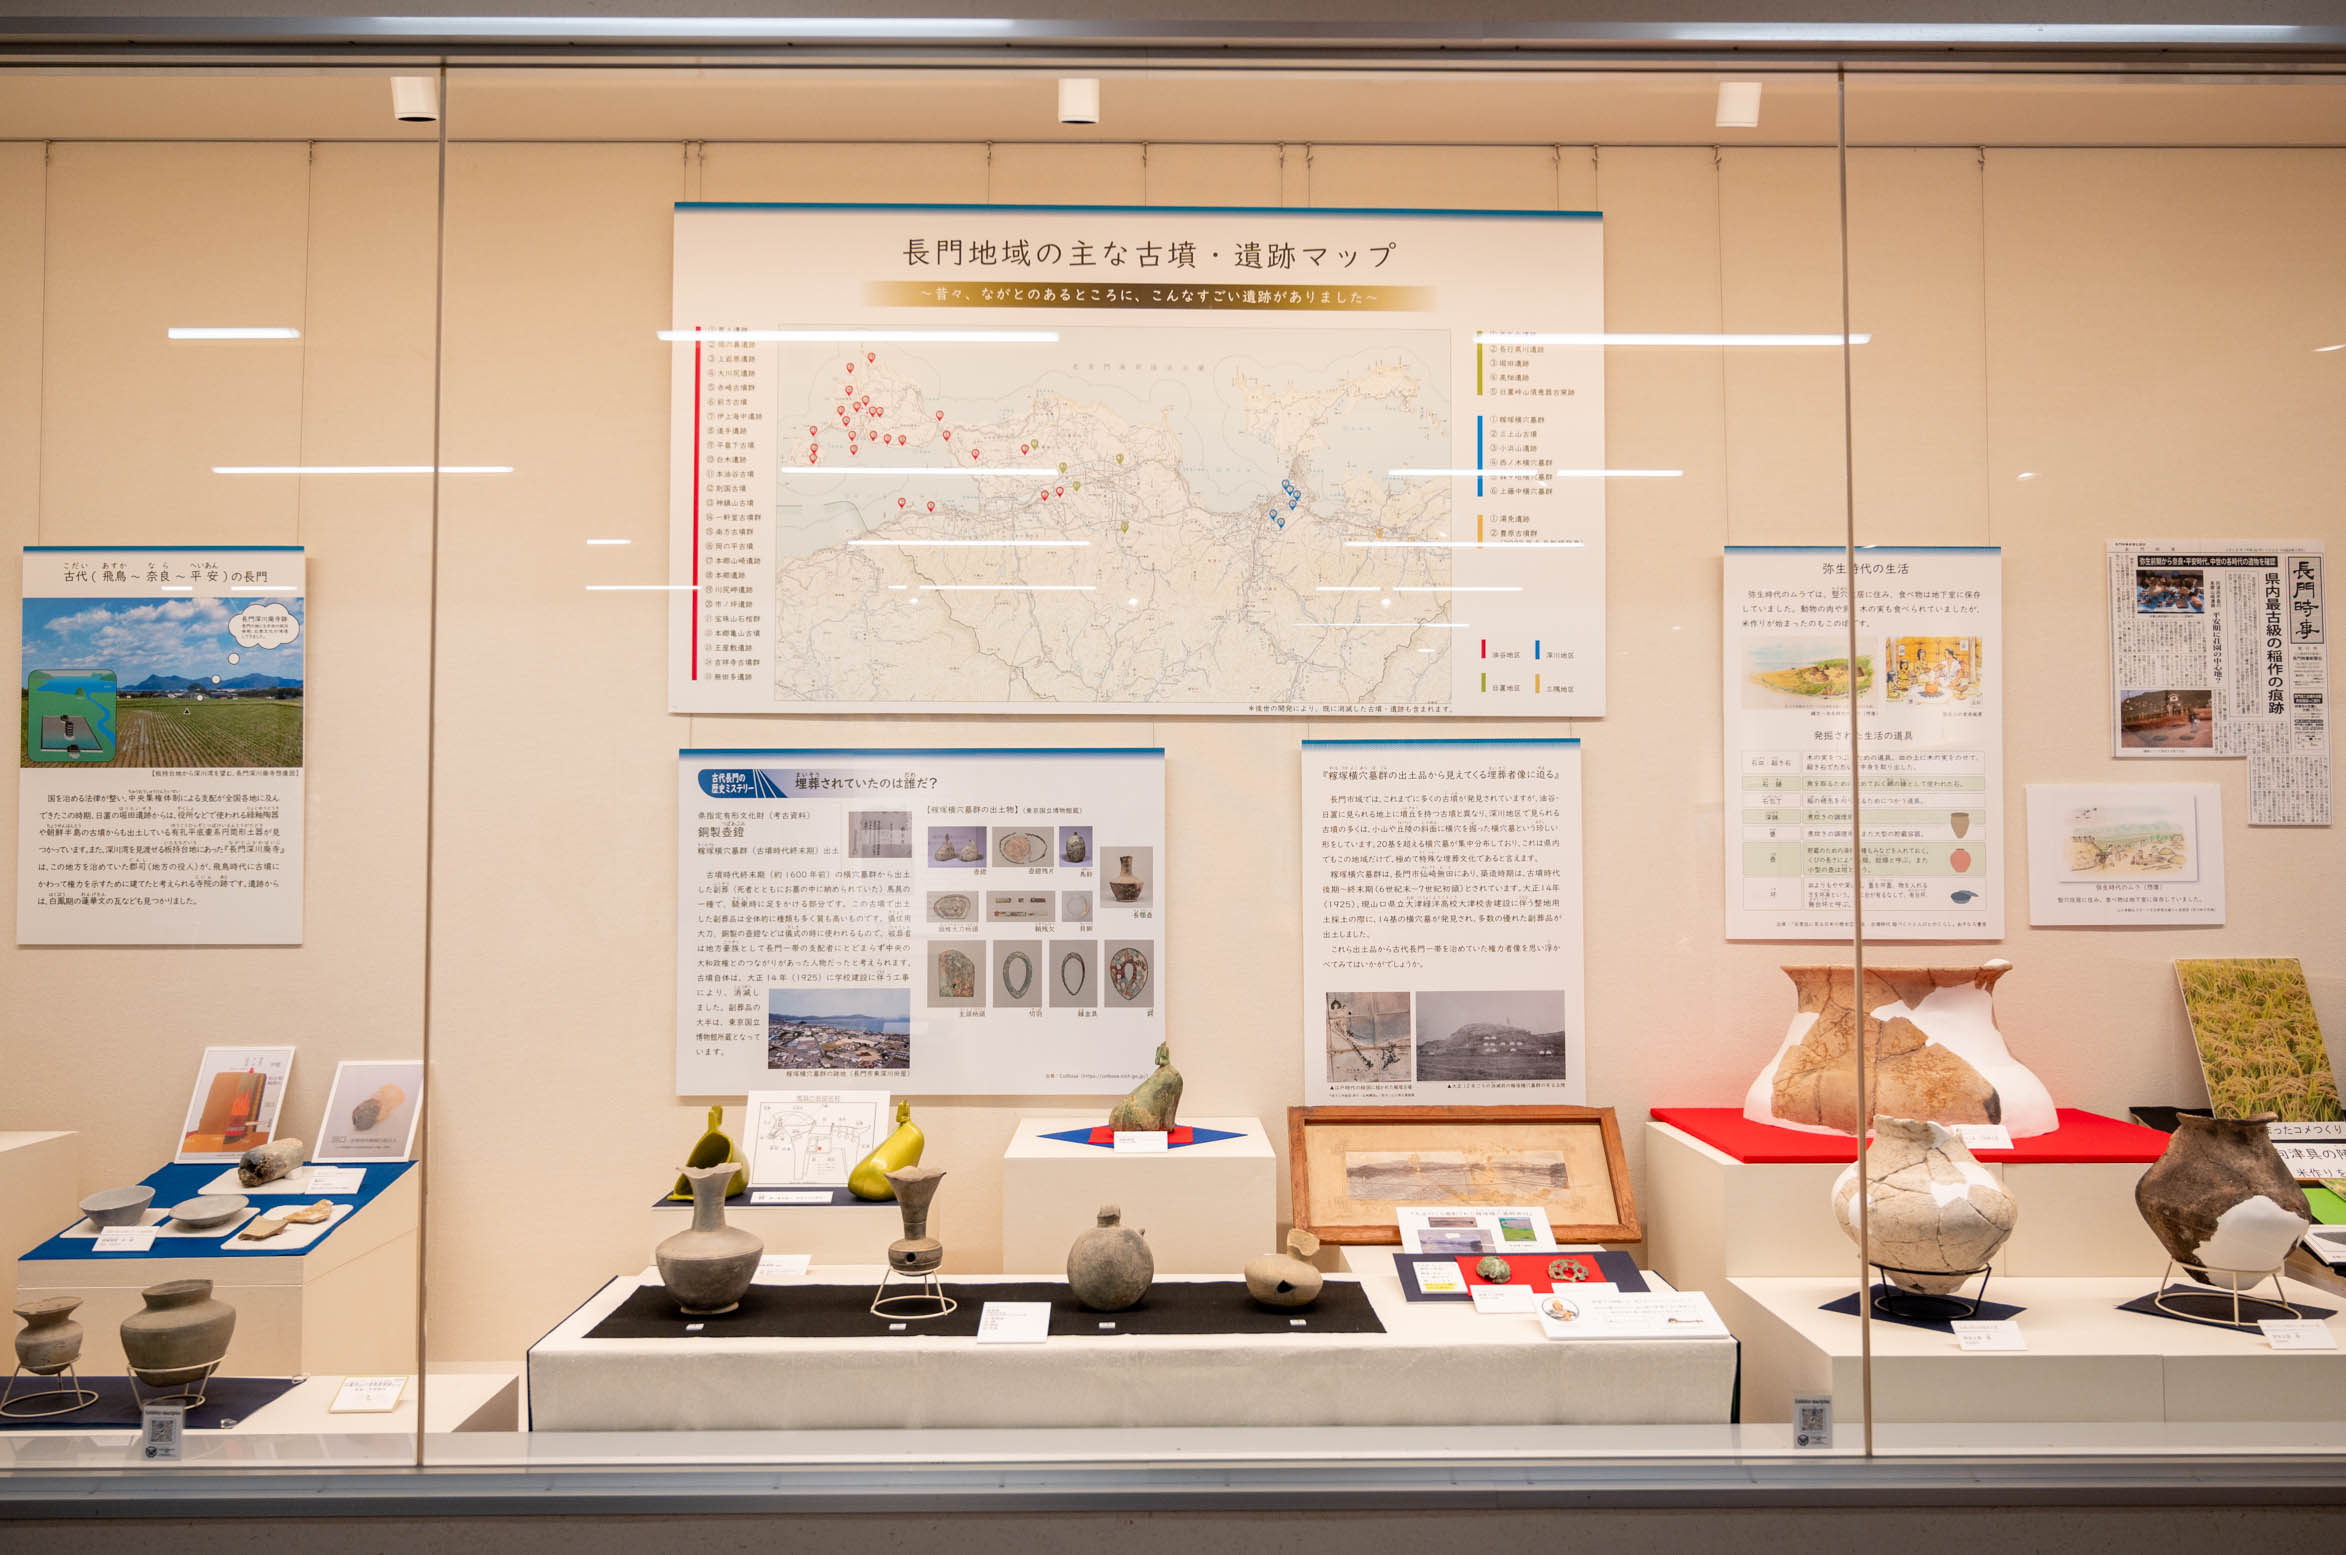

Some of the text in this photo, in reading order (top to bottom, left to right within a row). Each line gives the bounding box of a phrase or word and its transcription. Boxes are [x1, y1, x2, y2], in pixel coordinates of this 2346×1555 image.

[902, 236, 1400, 274] 長門地域の主な古墳・遺跡マップ
[2293, 561, 2320, 639] 長門時事
[2265, 572, 2284, 715] 県内最古級の稲作の痕跡
[711, 773, 745, 783] 古代長門の
[711, 784, 754, 794] 歴史ミステリー
